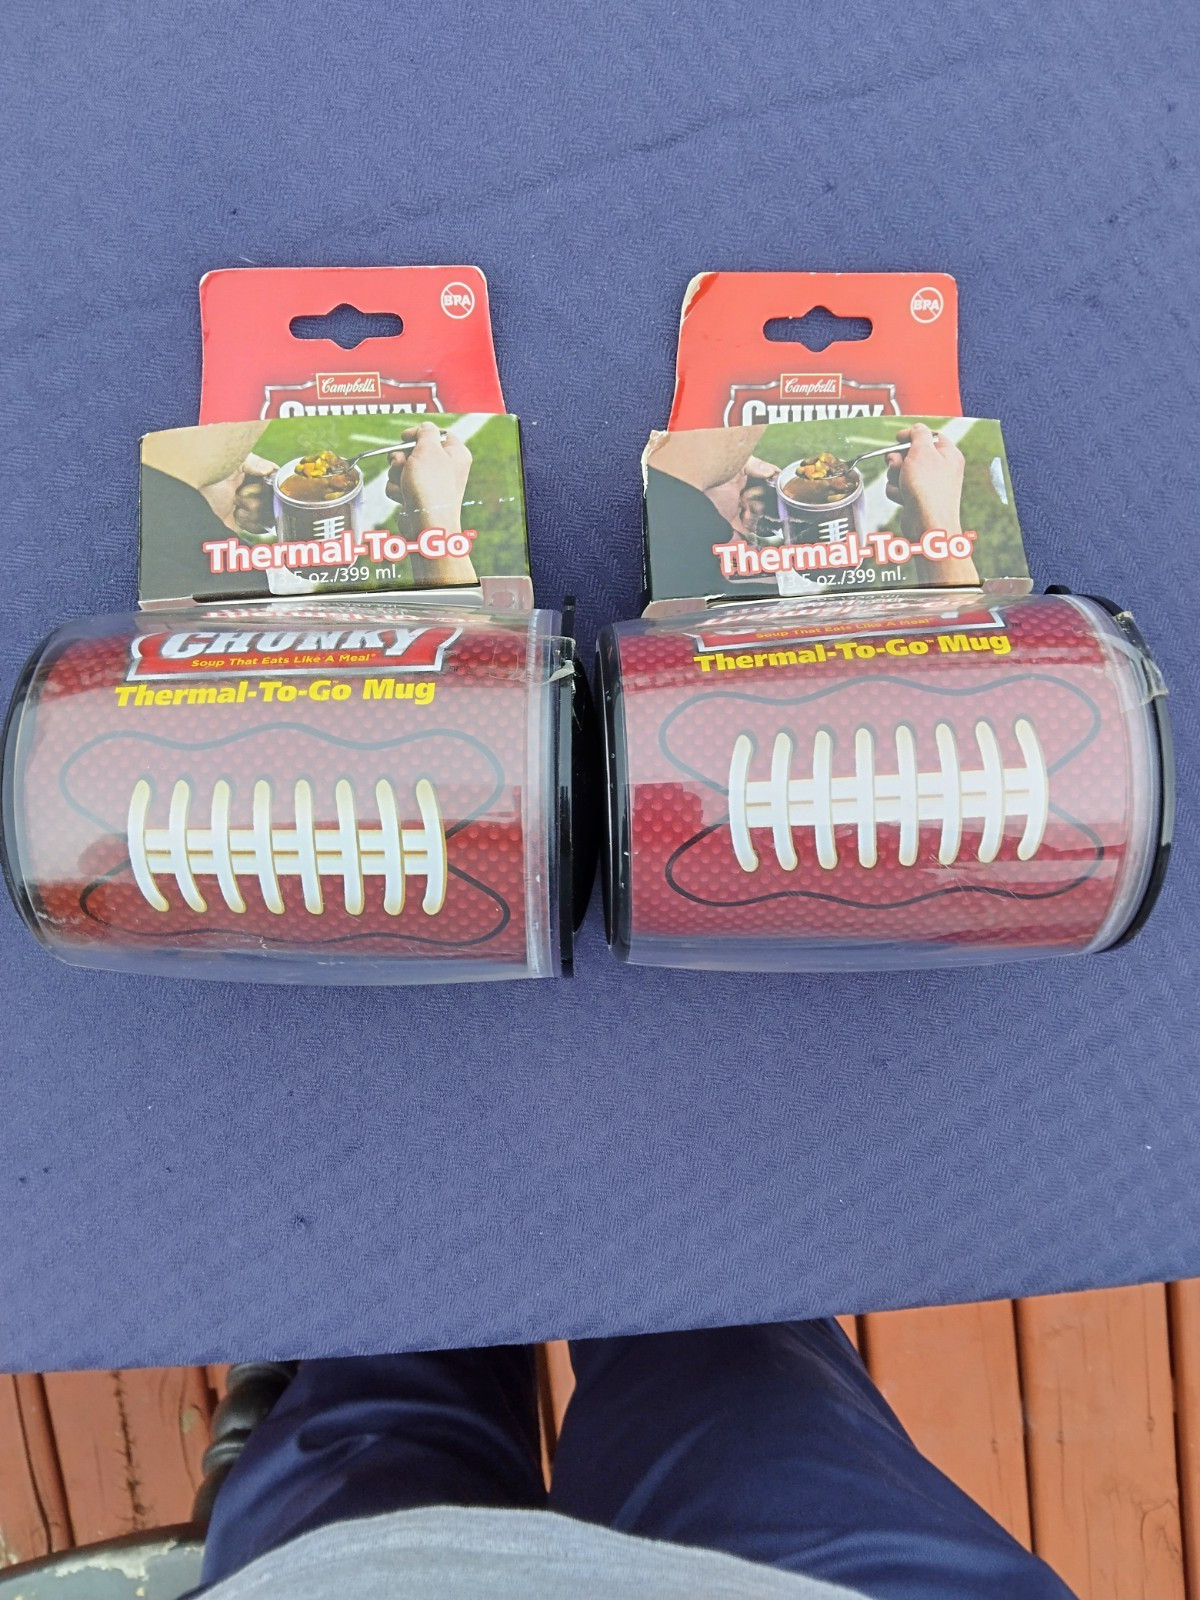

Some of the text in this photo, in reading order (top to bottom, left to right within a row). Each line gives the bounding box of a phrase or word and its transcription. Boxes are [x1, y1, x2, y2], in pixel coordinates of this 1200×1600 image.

[443, 294, 472, 306] BRA
[913, 299, 940, 311] BRA
[321, 377, 376, 396] Campbell's
[784, 378, 837, 396] Campbell's
[375, 564, 402, 580] ml.
[881, 566, 907, 582] ml.
[937, 634, 1012, 655] Mug
[191, 658, 225, 667] Soup
[229, 657, 258, 666] That
[261, 656, 290, 665] Eats
[293, 655, 321, 664] Like
[324, 655, 335, 663] A
[362, 678, 436, 705] Mug
